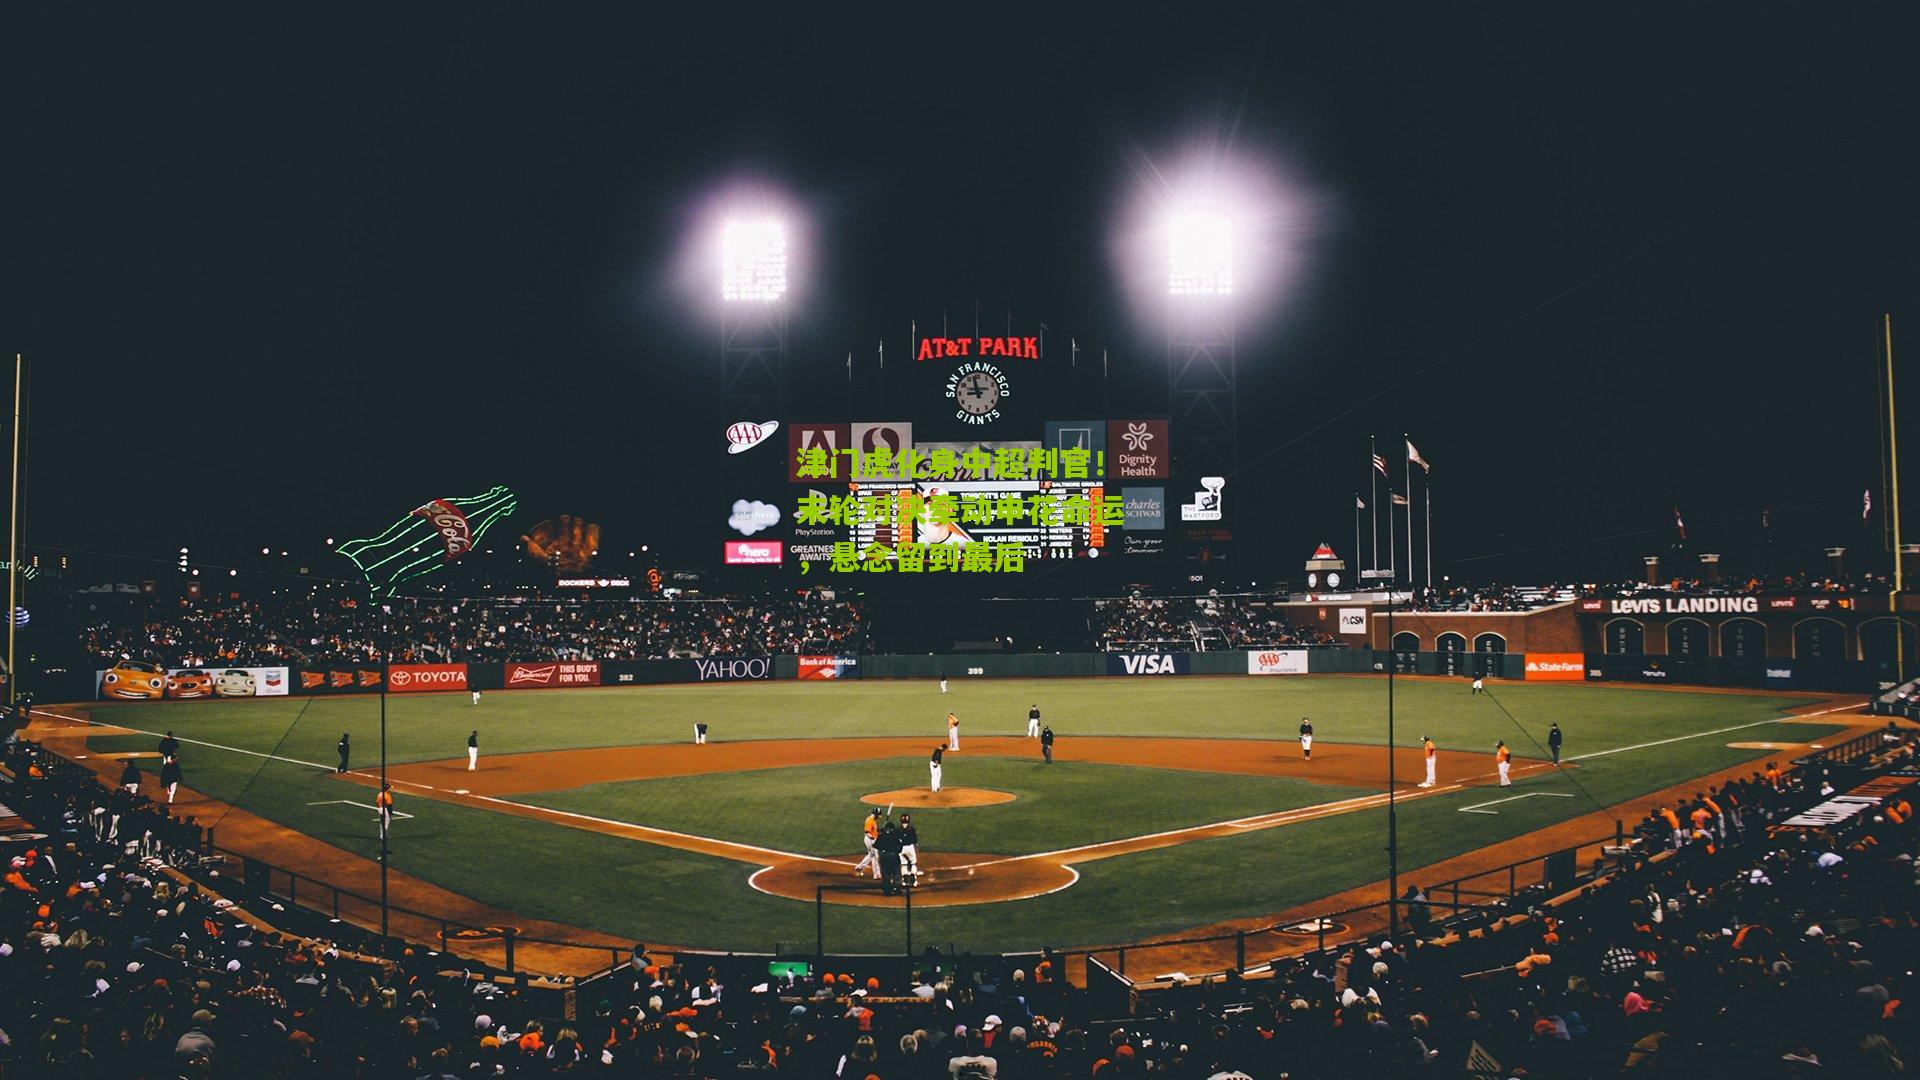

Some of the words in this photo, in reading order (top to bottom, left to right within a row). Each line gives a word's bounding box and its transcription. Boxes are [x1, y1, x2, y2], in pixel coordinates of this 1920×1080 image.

[918, 337, 972, 361] AT&T
[979, 336, 1038, 360] PARK
[945, 373, 960, 398] SAN
[958, 361, 1010, 397] FRANCISCO
[956, 409, 1001, 425] GIANTS
[1119, 454, 1157, 466] Dignity
[1121, 467, 1156, 476] Health
[1125, 498, 1160, 510] charles
[1125, 510, 1161, 518] SCHWAB
[795, 528, 835, 537] PlayStation
[790, 545, 835, 554] GREATNES
[799, 553, 832, 561] AWAITS
[1665, 597, 1758, 613] LANDING
[1350, 616, 1364, 625] CSN
[800, 658, 818, 666] Bank
[818, 658, 826, 666] of
[826, 658, 856, 666] America
[1119, 655, 1176, 674] VISA
[559, 665, 575, 673] THIS
[576, 664, 597, 673] BUD'S
[696, 658, 771, 680] YAHOO!
[413, 671, 467, 682] TOYOTA
[514, 670, 552, 679] Budweiser
[559, 674, 574, 683] FOR
[574, 673, 591, 682] YOU.
